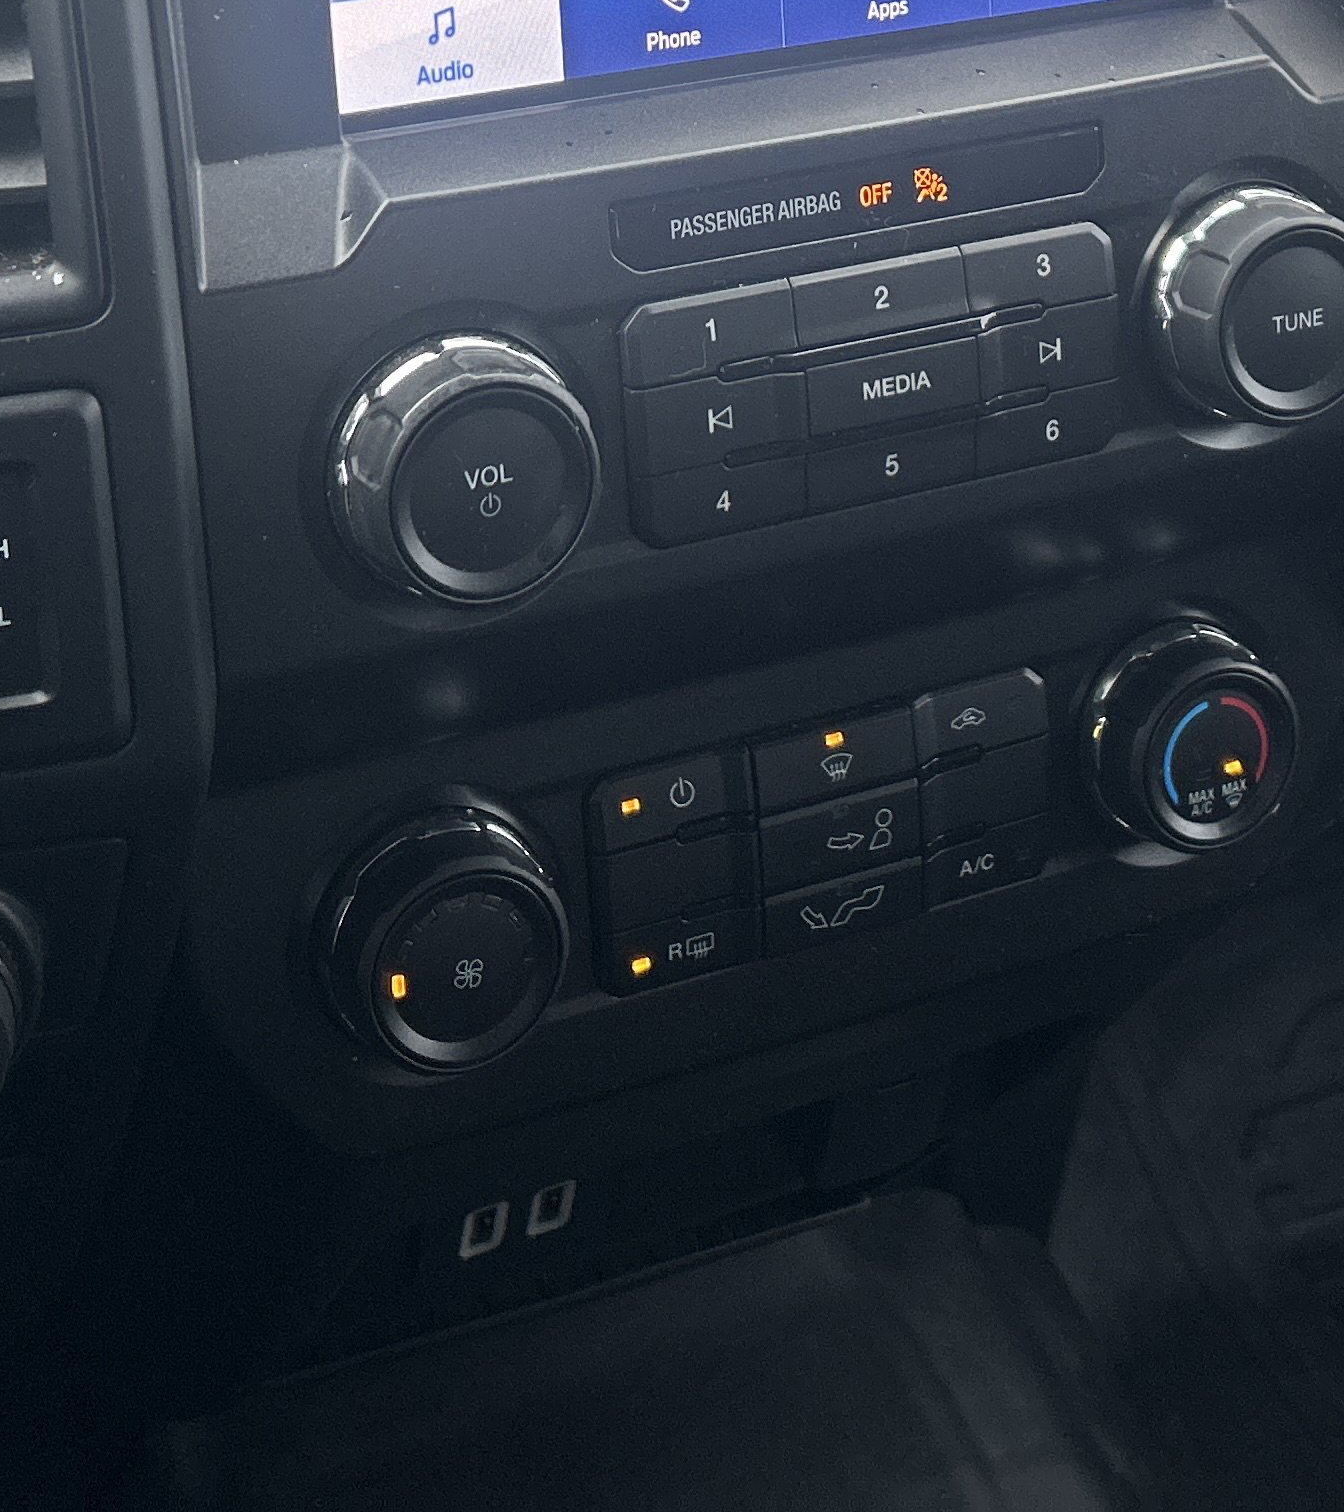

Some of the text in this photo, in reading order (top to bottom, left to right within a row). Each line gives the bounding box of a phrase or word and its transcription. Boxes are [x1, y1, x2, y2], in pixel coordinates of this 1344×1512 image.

[867, 0, 909, 22] Apps
[646, 30, 702, 52] Phone
[416, 60, 474, 86] Audio
[670, 181, 893, 240] PASSENGER AIRBAG OFF
[1036, 253, 1051, 277] 3
[874, 285, 890, 310] 2
[705, 318, 717, 342] 1
[1271, 307, 1324, 334] TUNE
[862, 370, 932, 401] MEDIA
[1045, 419, 1060, 442] 6
[464, 463, 514, 490] VOL
[885, 453, 899, 477] 5
[716, 490, 732, 512] 4
[1188, 788, 1215, 805] MAX
[1221, 779, 1247, 796] MAX
[959, 853, 994, 877] A/C
